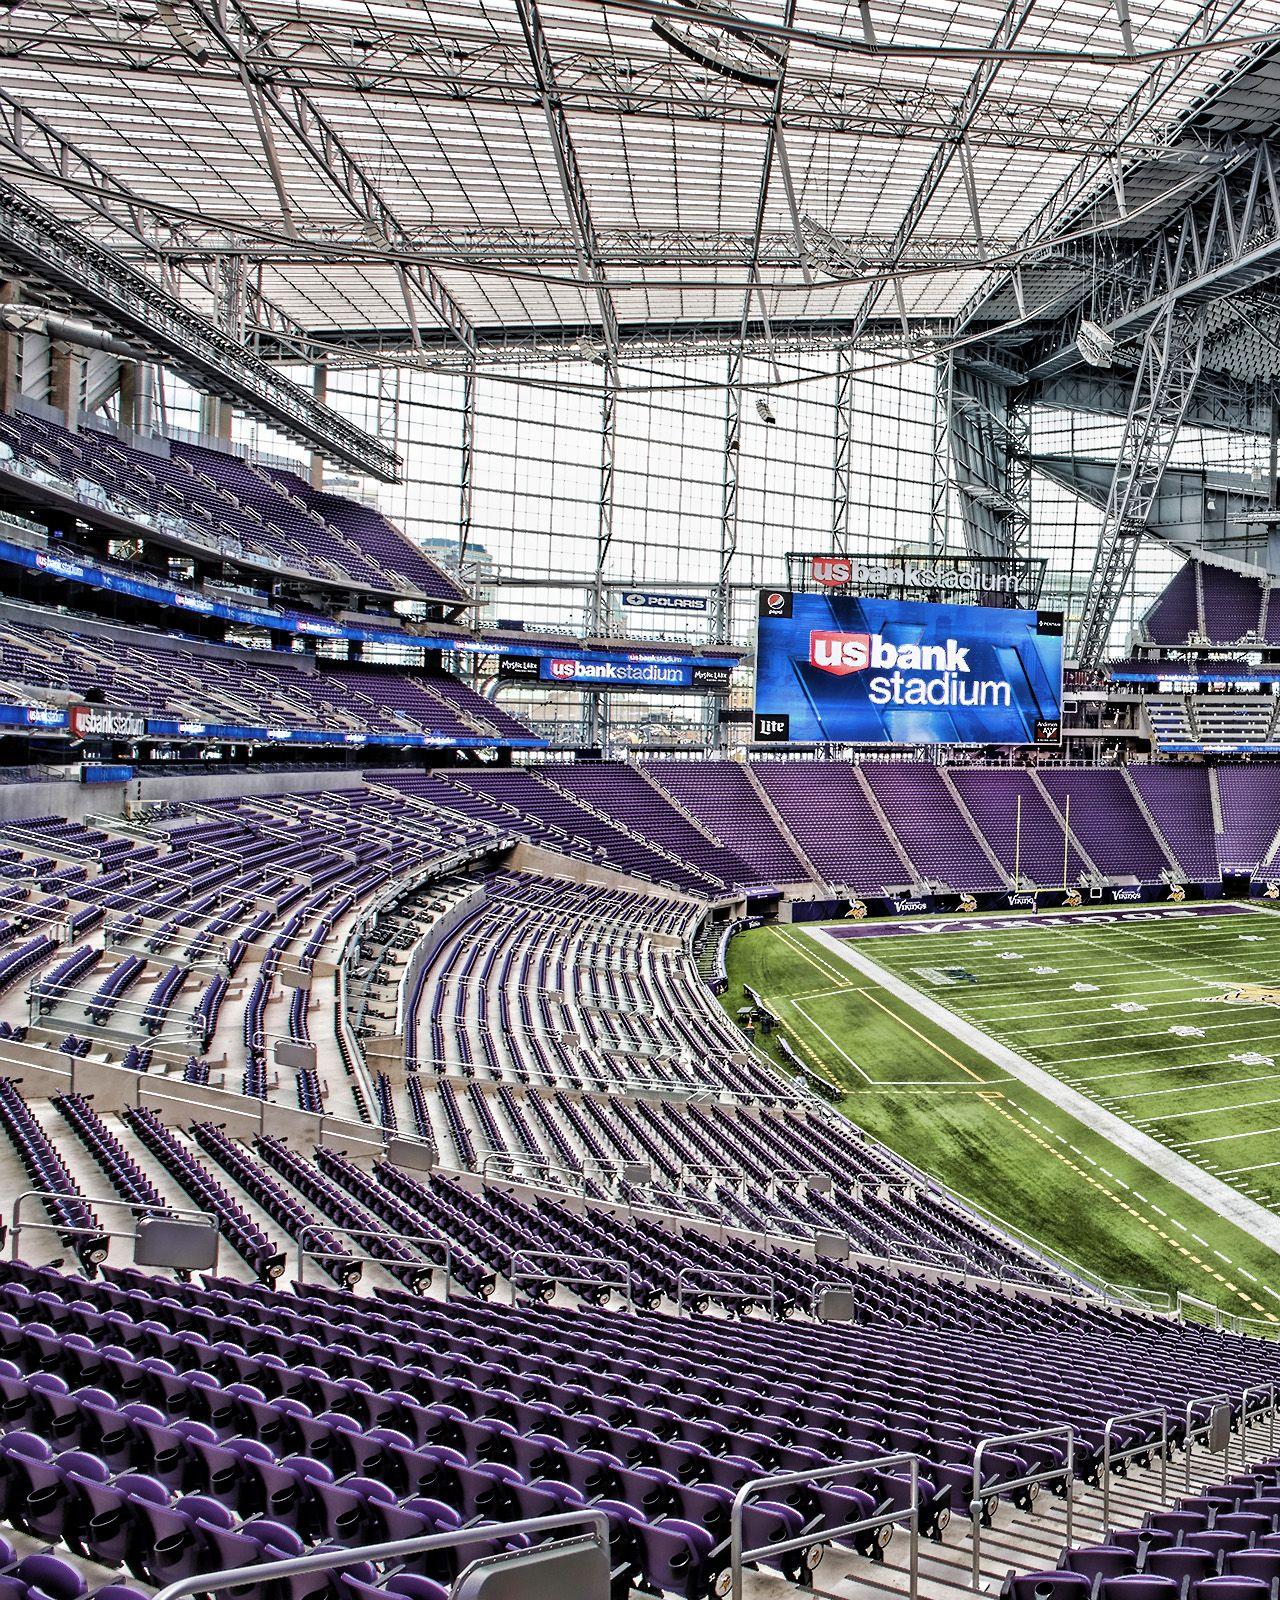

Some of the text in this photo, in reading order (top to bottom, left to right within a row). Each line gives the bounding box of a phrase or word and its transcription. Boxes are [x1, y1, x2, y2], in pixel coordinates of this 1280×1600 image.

[648, 596, 705, 609] POLARIS
[868, 672, 1011, 706] stadium
[760, 719, 785, 735] Lite
